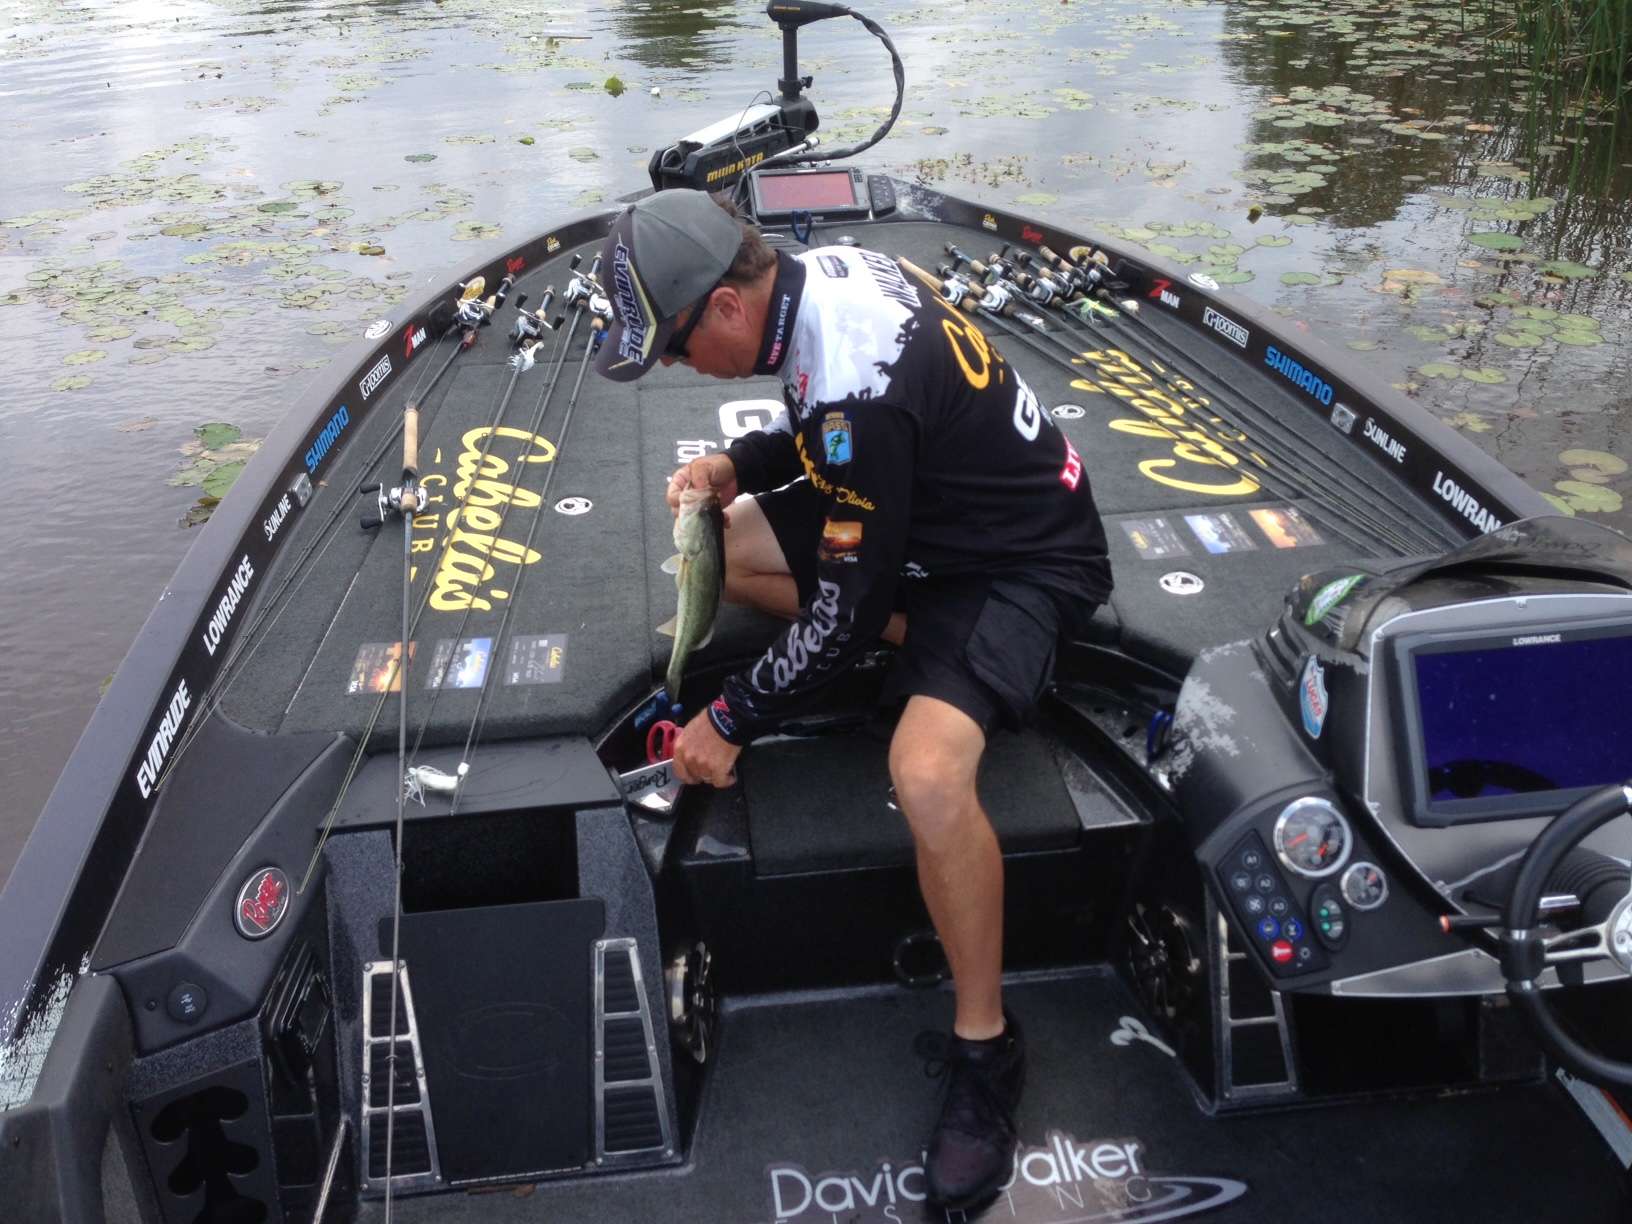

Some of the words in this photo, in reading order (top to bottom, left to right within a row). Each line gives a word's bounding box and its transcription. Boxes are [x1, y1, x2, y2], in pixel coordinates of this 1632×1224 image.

[613, 243, 645, 366] EVINRUDE
[1264, 344, 1334, 406] SHIMANO
[304, 404, 349, 474] SHIMANO
[1362, 417, 1407, 464] SUNLINE
[264, 493, 292, 542] SUNLINE
[1432, 470, 1504, 535] LOWRAN
[203, 554, 255, 656] LOWRANCE
[1512, 633, 1562, 646] LOWRANCE
[136, 678, 192, 800] EVINRUDE
